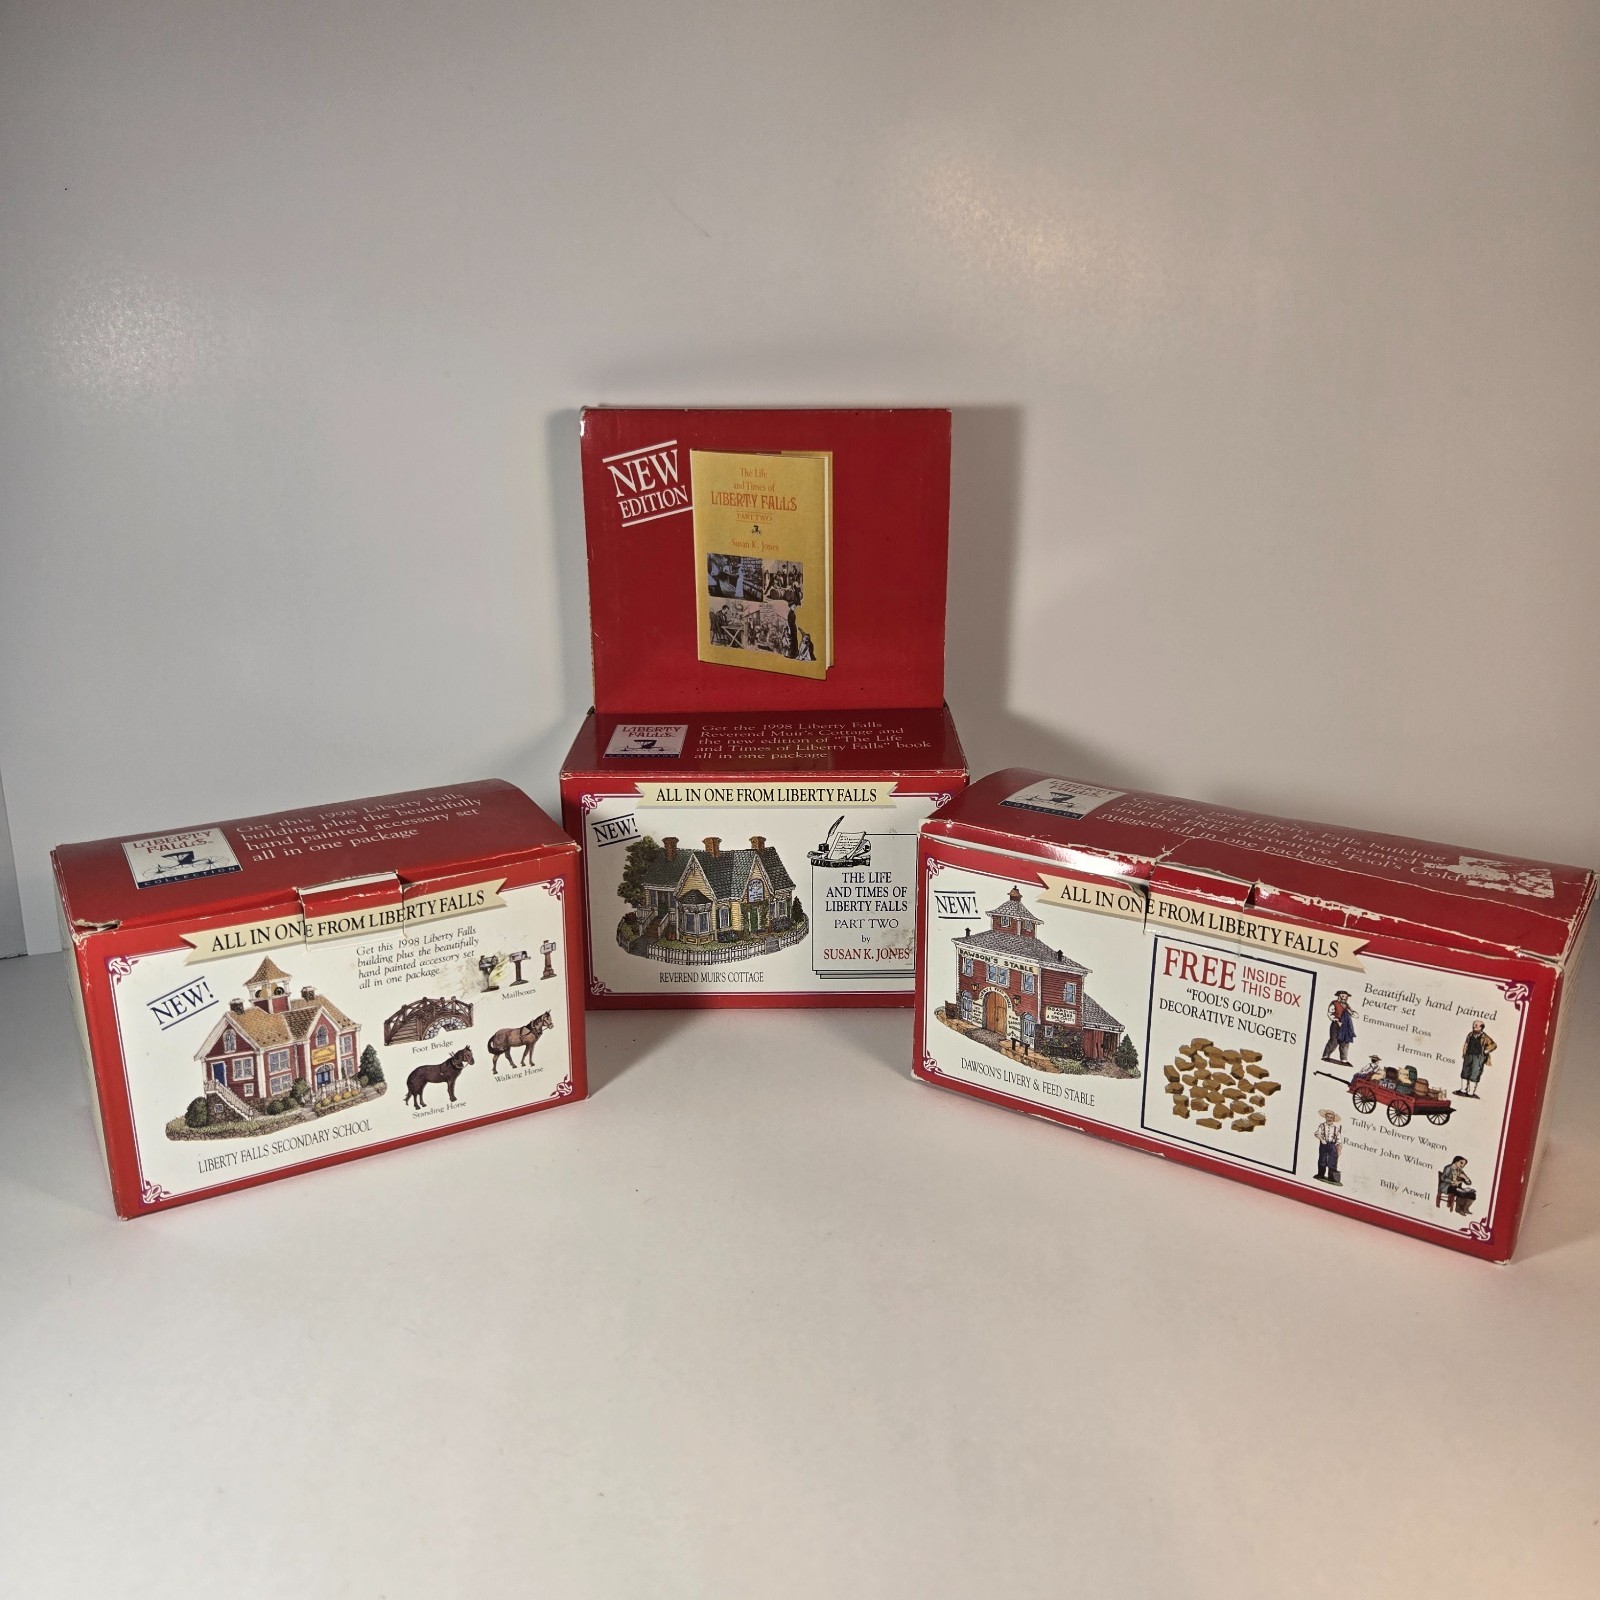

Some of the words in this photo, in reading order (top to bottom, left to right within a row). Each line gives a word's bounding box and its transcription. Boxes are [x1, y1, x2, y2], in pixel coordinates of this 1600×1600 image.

[607, 449, 678, 497] NEW
[618, 485, 689, 519] EDITION
[711, 491, 758, 508] LIBERTY
[761, 495, 797, 511] FALLS
[731, 538, 750, 549] Susan
[752, 541, 760, 550] K.
[761, 541, 779, 552] Jones
[771, 752, 827, 760] package
[656, 788, 682, 801] ALL
[686, 788, 701, 801] IN
[704, 788, 734, 802] ONE
[737, 788, 774, 802] FROM
[777, 788, 834, 801] LIBERTY
[837, 788, 877, 802] FALLS
[237, 824, 271, 832] Get
[279, 817, 311, 827] this
[319, 809, 357, 819] 1998
[364, 800, 421, 813] Liberty
[427, 793, 464, 803] Falls
[240, 825, 316, 841] building
[322, 818, 357, 830] plus
[364, 813, 390, 822] the
[396, 798, 481, 816] beautifully
[133, 831, 212, 848] LIBERTY
[245, 836, 294, 851] hand
[301, 824, 367, 844] painted
[373, 813, 449, 831] accessory
[456, 808, 480, 817] set
[592, 818, 638, 842] NEW!
[147, 838, 207, 853] FALLS
[253, 849, 276, 862] all
[282, 848, 303, 857] in
[309, 841, 343, 852] one
[350, 829, 419, 847] package
[842, 872, 865, 883] THE
[869, 872, 892, 883] LIFE
[826, 886, 852, 898] AND
[855, 886, 889, 898] TIMES
[892, 886, 908, 898] OF
[825, 900, 872, 912] LIBERTY
[875, 900, 908, 912] FALLS
[935, 896, 979, 914] NEW!
[211, 935, 247, 952] ALL
[250, 927, 271, 945] IN
[274, 920, 313, 939] ONE
[318, 915, 366, 937] FROM
[369, 900, 438, 928] LIBERTY
[440, 889, 485, 913] FALLS
[834, 918, 866, 928] PART
[868, 918, 899, 928] TWO
[1060, 884, 1091, 904] ALL
[1095, 892, 1115, 907] IN
[1118, 895, 1154, 914] ONE
[1158, 902, 1205, 925] FROM
[1208, 912, 1281, 944] LIBERTY
[1285, 930, 1339, 958] FALLS
[356, 946, 374, 956] Get
[378, 943, 393, 952] this
[398, 937, 420, 949] 1998
[424, 931, 453, 945] Liberty
[457, 926, 477, 937] Falls
[861, 934, 871, 944] by
[357, 954, 393, 967] building
[396, 950, 414, 962] plus
[418, 947, 431, 957] the
[434, 936, 479, 953] beautifully
[823, 948, 862, 960] SUSAN
[864, 948, 874, 959] K.
[875, 948, 910, 961] JONES
[358, 965, 381, 979] hand
[384, 960, 416, 976] painted
[419, 954, 460, 967] accessory
[463, 950, 475, 958] set
[1004, 960, 1034, 973] STABLE
[1163, 946, 1236, 991] FREE
[359, 979, 370, 990] all
[374, 977, 383, 987] in
[386, 976, 402, 985] one
[405, 967, 440, 982] package
[659, 972, 698, 982] REVEREND
[700, 972, 726, 982] MUIR'S
[727, 972, 764, 982] COTTAGE
[1242, 965, 1287, 988] INSIDE
[150, 981, 214, 1025] NEW!
[502, 989, 536, 1001] Mailboxes
[1186, 987, 1229, 1009] "FOOL'S
[1232, 999, 1273, 1019] GOLD"
[1241, 979, 1271, 999] THIS
[1274, 989, 1301, 1007] BOX
[1364, 982, 1422, 1006] Beautifully
[1425, 996, 1453, 1011] hand
[1455, 1005, 1498, 1021] painted
[1361, 997, 1398, 1012] pewter
[1401, 1006, 1416, 1016] set
[1159, 998, 1234, 1027] DECORATIVE
[1237, 1018, 1297, 1044] NUGGETS
[1363, 1014, 1408, 1032] Emmanuel
[1412, 1025, 1432, 1037] Ross
[412, 1045, 429, 1054] Foot
[431, 1040, 454, 1050] Bridge
[1397, 1043, 1432, 1059] Herman
[1436, 1052, 1456, 1064] Ross
[495, 1071, 522, 1083] Walking
[524, 1066, 544, 1076] Horse
[961, 1057, 1002, 1080] DAWSON'S
[1003, 1070, 1031, 1089] LIVERY
[1032, 1079, 1040, 1091] &
[1042, 1081, 1062, 1097] FEED
[1064, 1087, 1095, 1106] STABLE
[413, 1106, 444, 1119] Standing
[446, 1101, 467, 1110] Horse
[1351, 1117, 1377, 1131] Tully's
[1379, 1126, 1415, 1143] Delivery
[1418, 1135, 1447, 1151] Wagon
[198, 1152, 238, 1173] LIBERTY
[240, 1144, 270, 1163] FALLS
[271, 1129, 330, 1154] SECONDARY
[332, 1119, 372, 1140] SCHOOL
[1343, 1137, 1378, 1153] Rancher
[1379, 1148, 1400, 1160] John
[1404, 1154, 1433, 1169] Wilson
[1380, 1179, 1399, 1192] Billy
